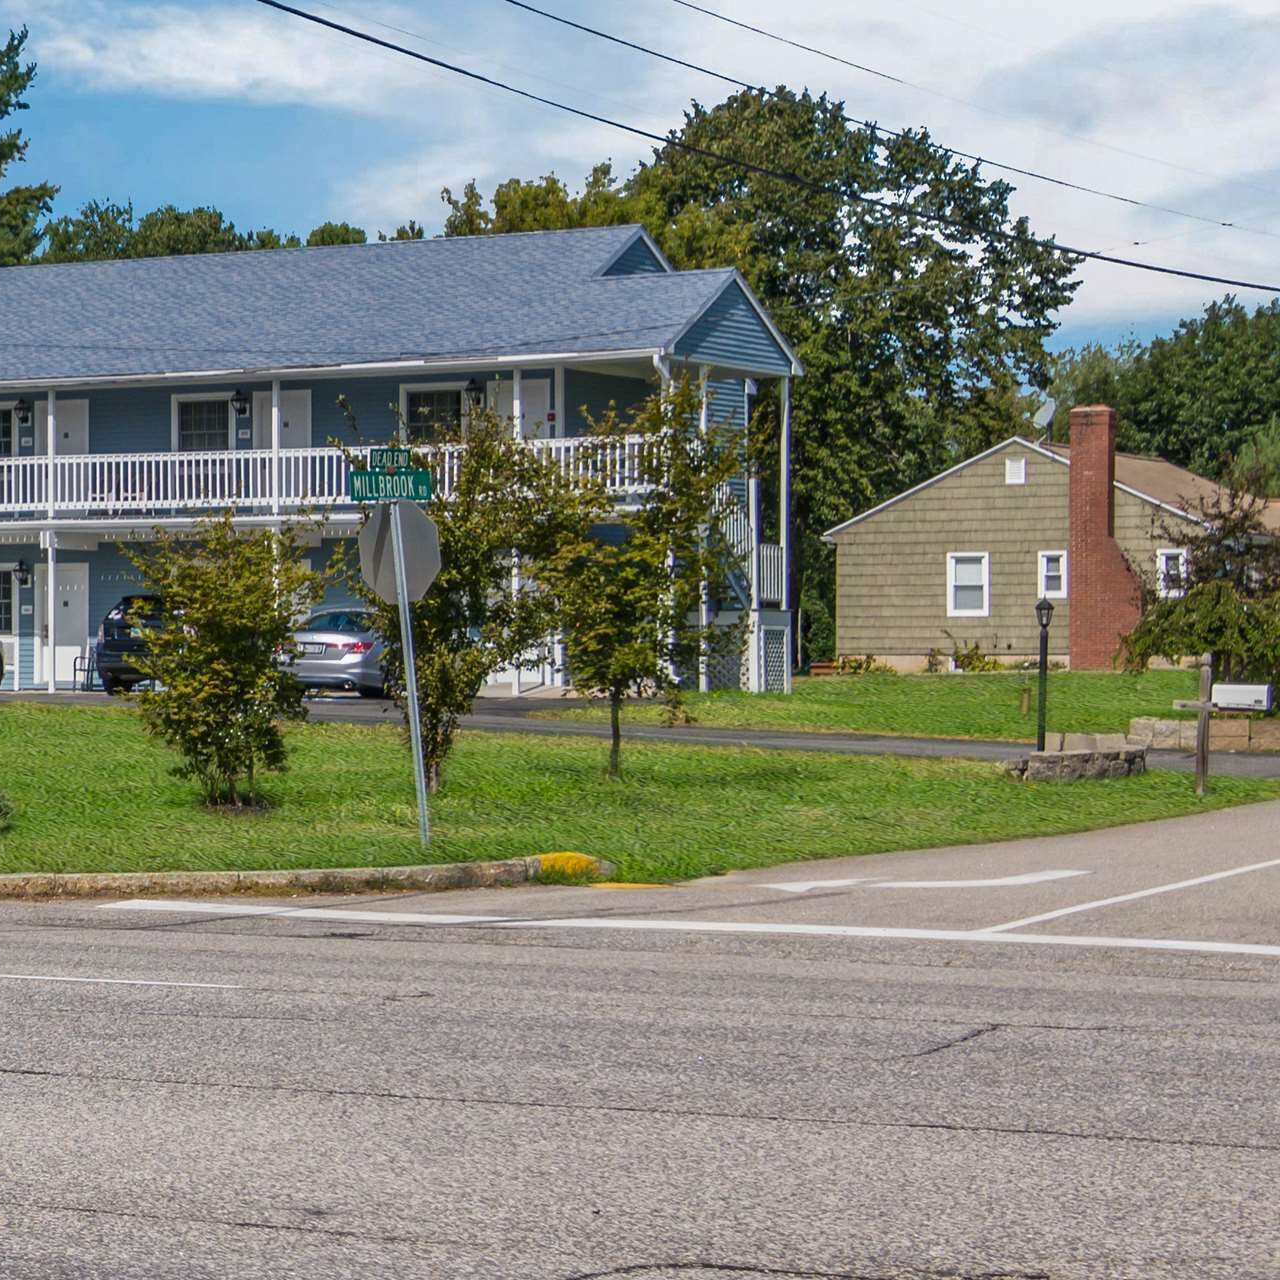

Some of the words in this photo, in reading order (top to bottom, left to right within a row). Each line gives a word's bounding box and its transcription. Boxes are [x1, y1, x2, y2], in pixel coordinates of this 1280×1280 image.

[372, 451, 393, 466] DEAD
[394, 452, 408, 467] END
[353, 475, 415, 497] MILLBROOK
[418, 484, 428, 497] RD
